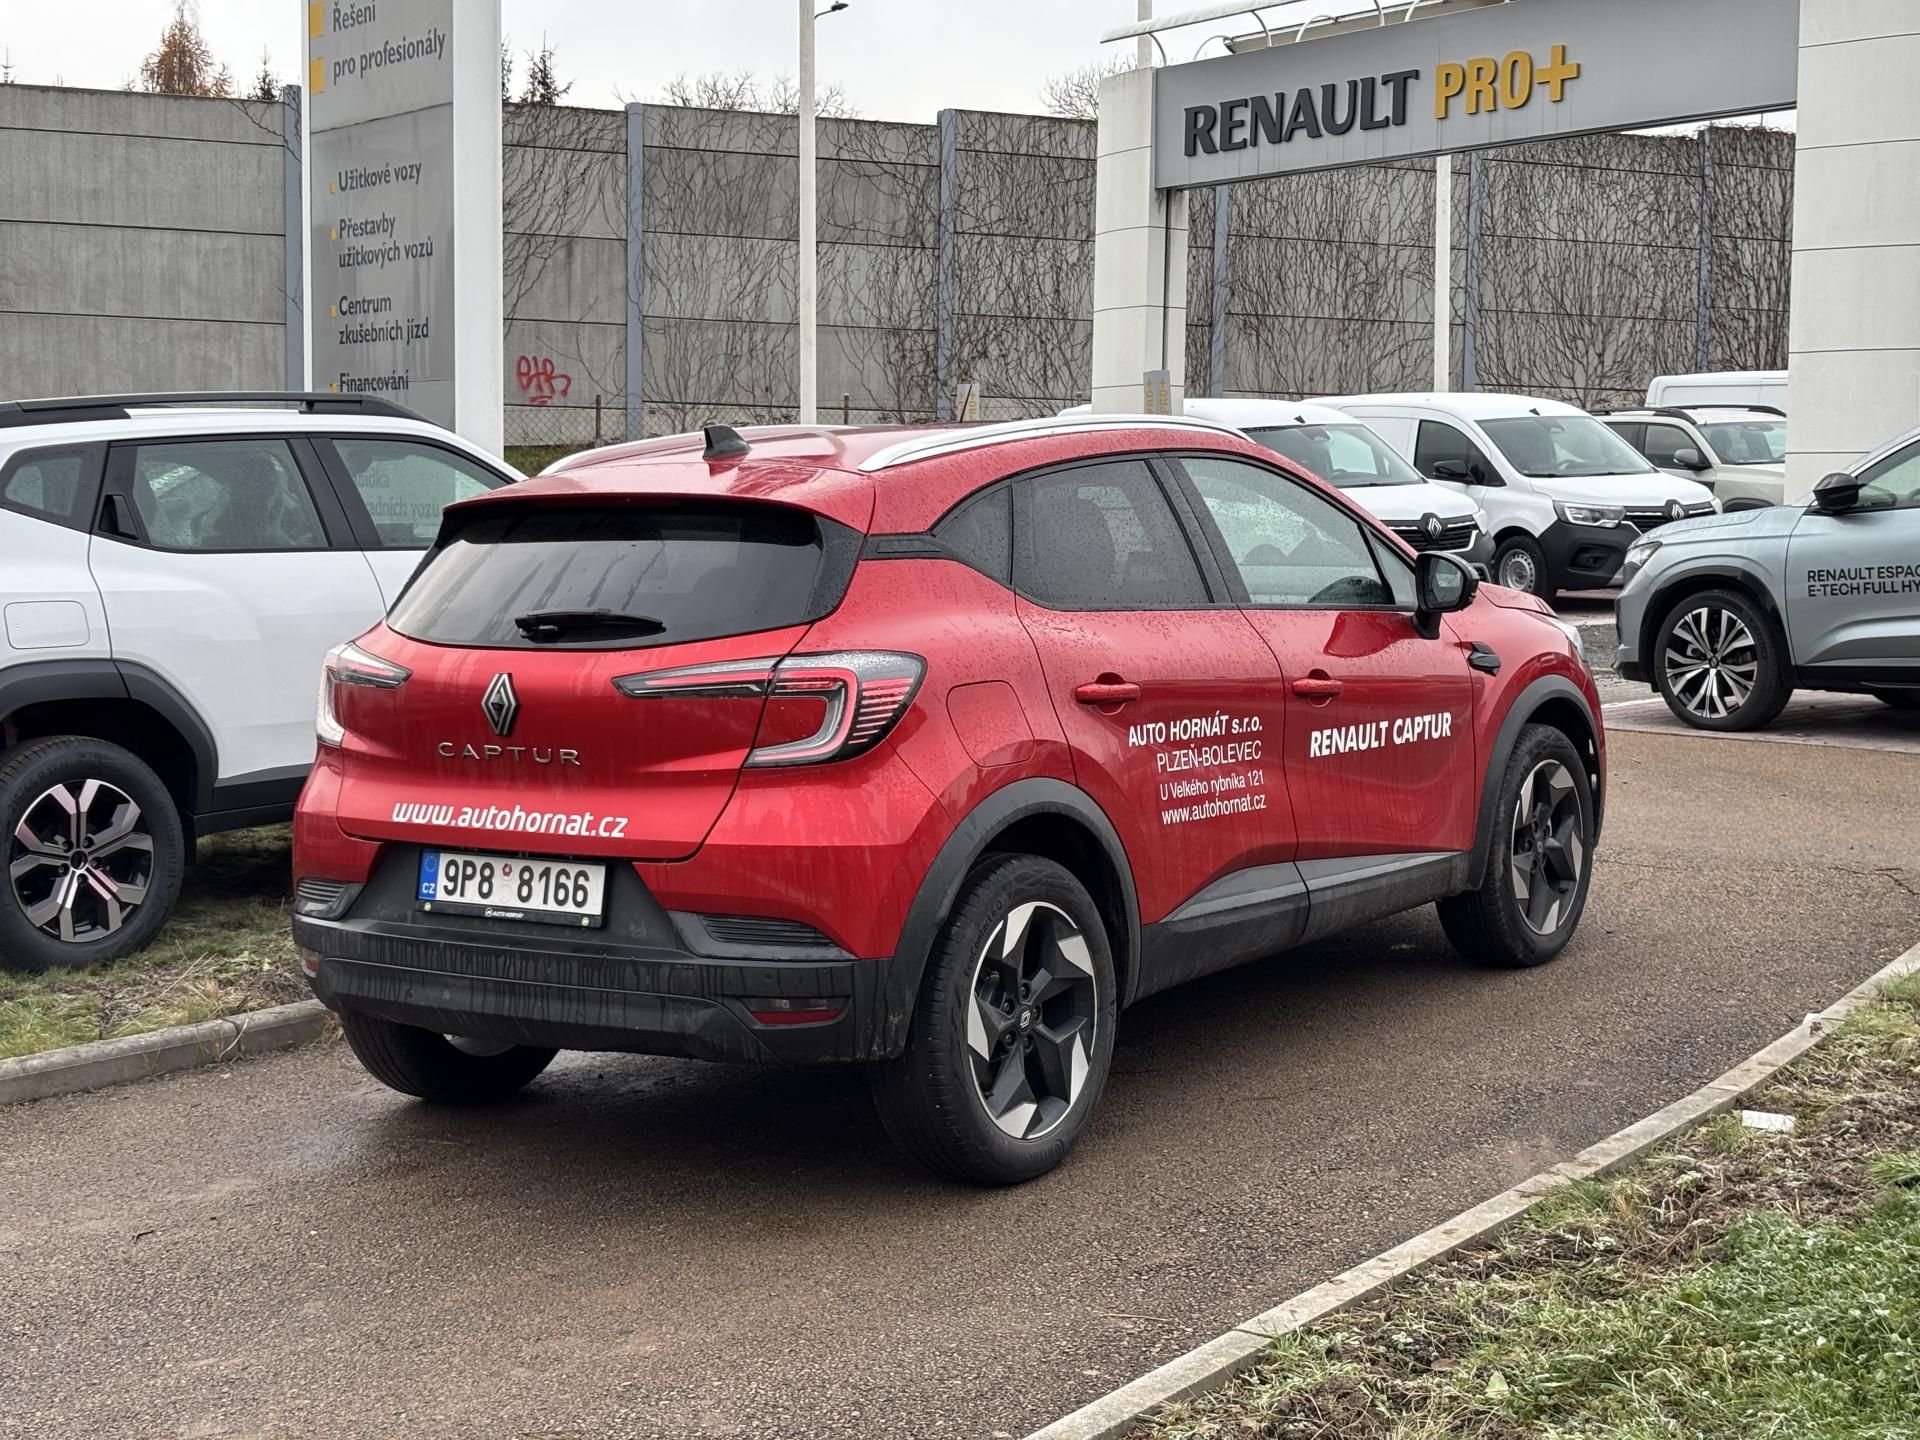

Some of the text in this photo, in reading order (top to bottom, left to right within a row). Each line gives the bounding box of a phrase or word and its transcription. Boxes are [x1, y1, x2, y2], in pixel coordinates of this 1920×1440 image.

[333, 0, 376, 32] Řešení
[333, 27, 446, 86] pro profesionály
[1183, 44, 1580, 158] RENAULT PRO+
[338, 162, 422, 192] Užitkové vozy
[339, 212, 396, 240] Přestavby
[339, 235, 433, 270] užitkových vozů
[338, 295, 392, 316] Centrum
[338, 316, 430, 346] zkušebních jízd
[339, 368, 409, 393] Financování
[1807, 567, 1875, 583] RENAULT
[1807, 582, 1860, 597] E-TECH
[1863, 580, 1899, 595] FULL
[1128, 710, 1263, 748] AUTO HORNÁT s.r.o.
[1310, 711, 1452, 758] RENAULT CAPTUR
[437, 742, 581, 766] CAPTUR
[1157, 739, 1262, 773] PLZEŇ-BOLEVEC
[1160, 769, 1264, 801] U Velkého rybníka 121
[392, 802, 629, 838] www.autohornat.cz
[1161, 794, 1267, 825] www.autohornat.cz
[422, 882, 436, 894] CZ
[443, 858, 590, 908] 9P8 8166
